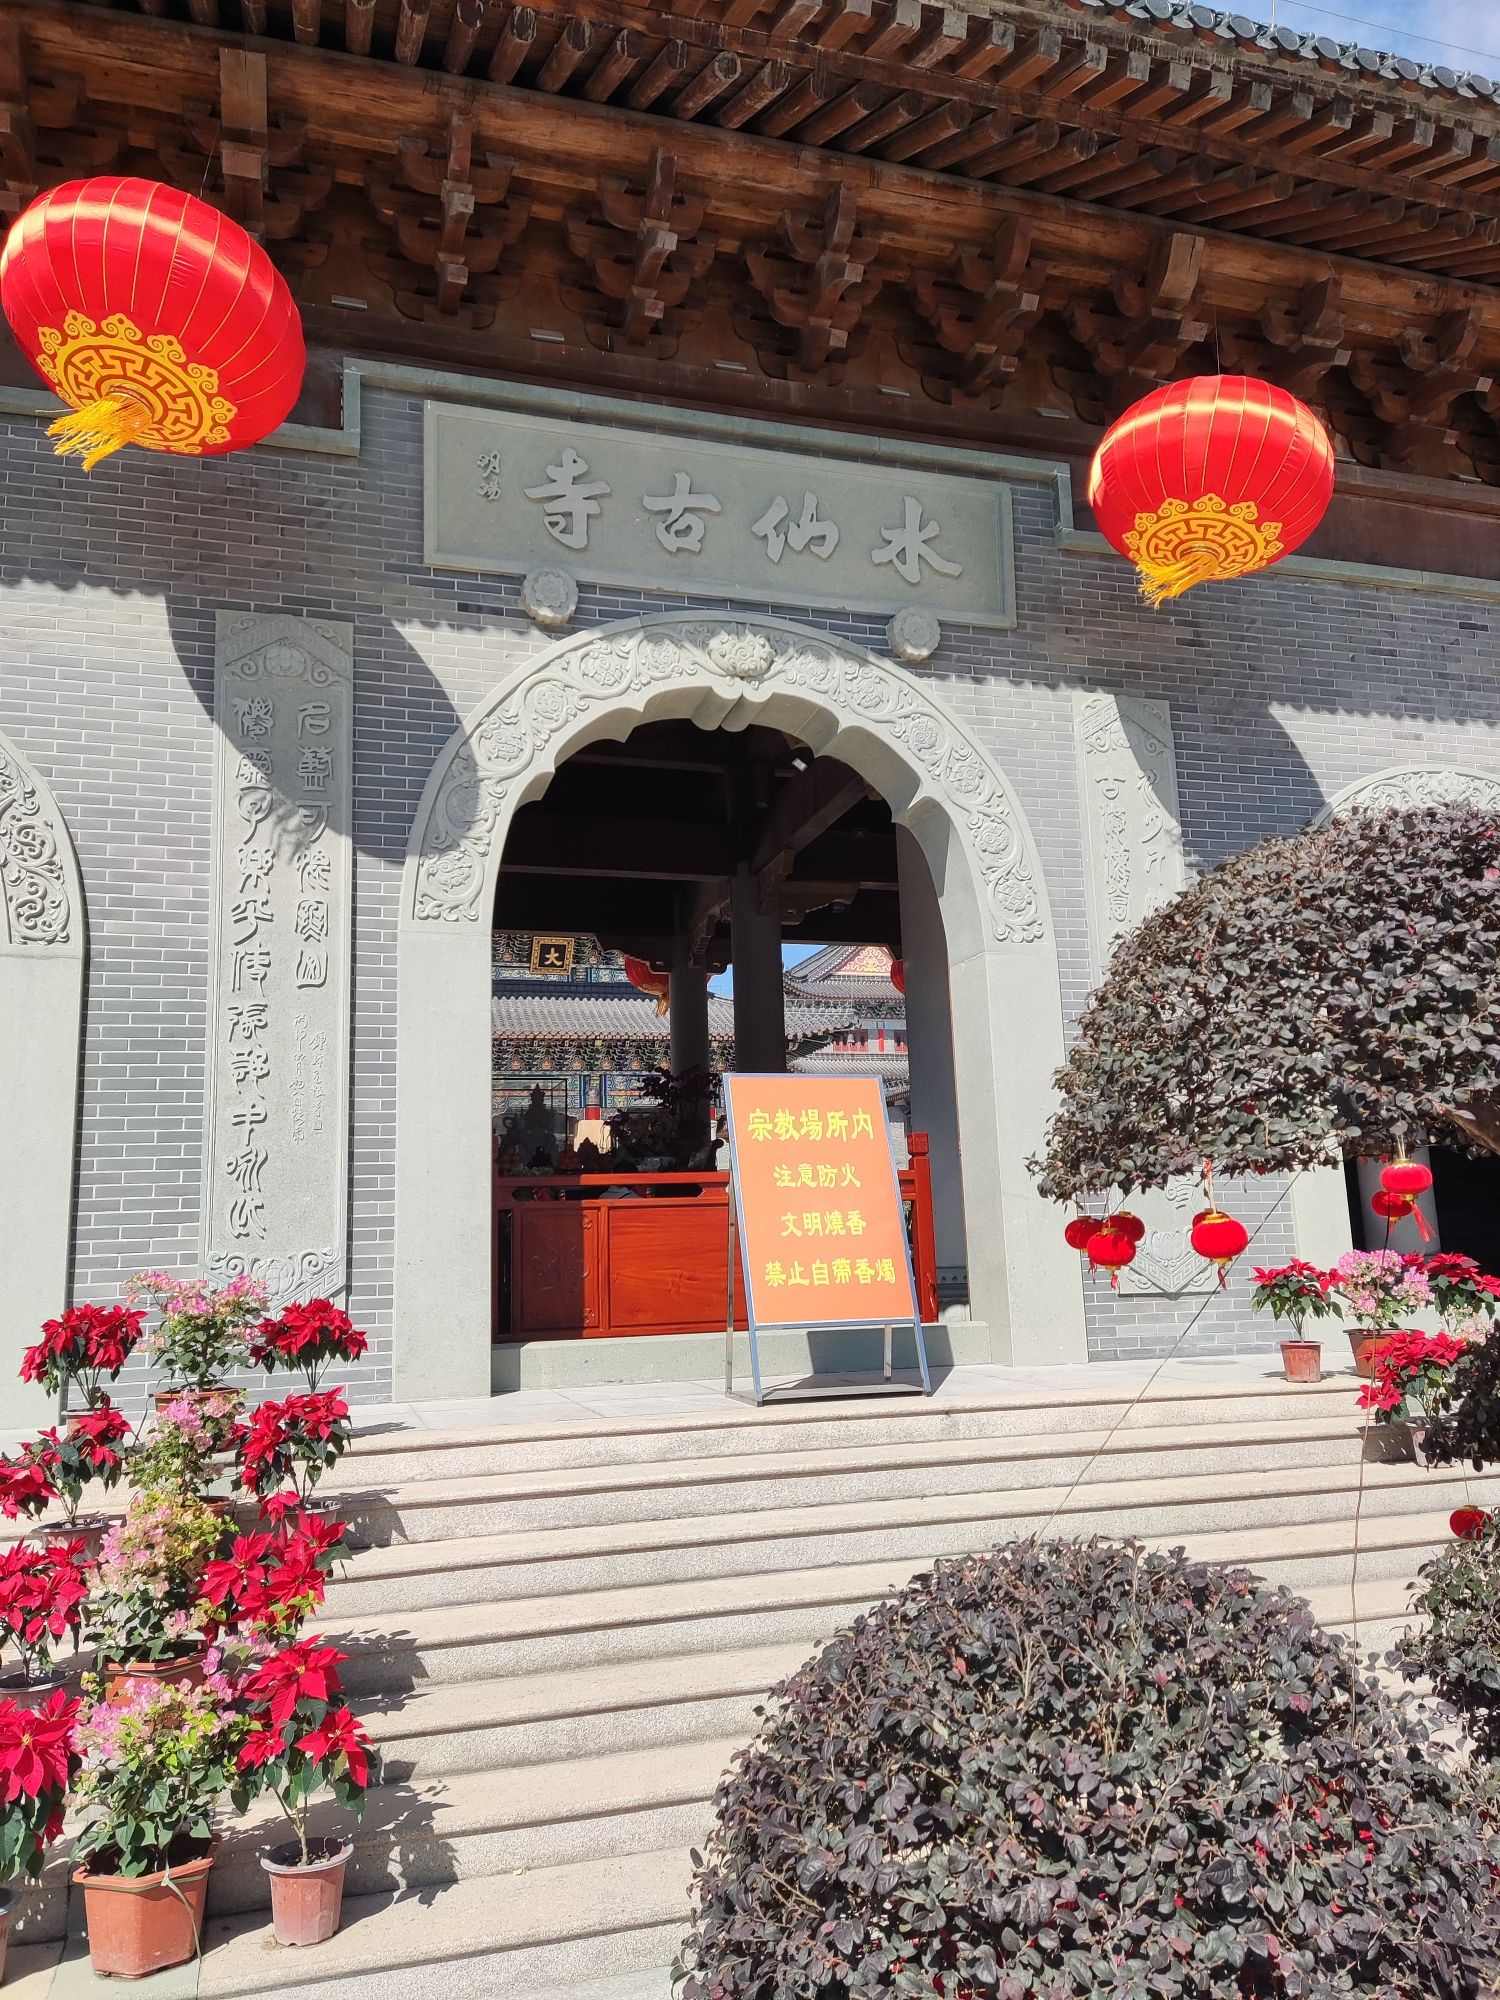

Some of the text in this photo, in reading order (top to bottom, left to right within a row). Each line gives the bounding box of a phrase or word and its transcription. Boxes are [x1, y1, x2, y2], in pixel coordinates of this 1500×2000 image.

[544, 947, 563, 966] 大
[773, 1162, 862, 1188] 注意防火
[780, 1209, 867, 1237] 文明燒香
